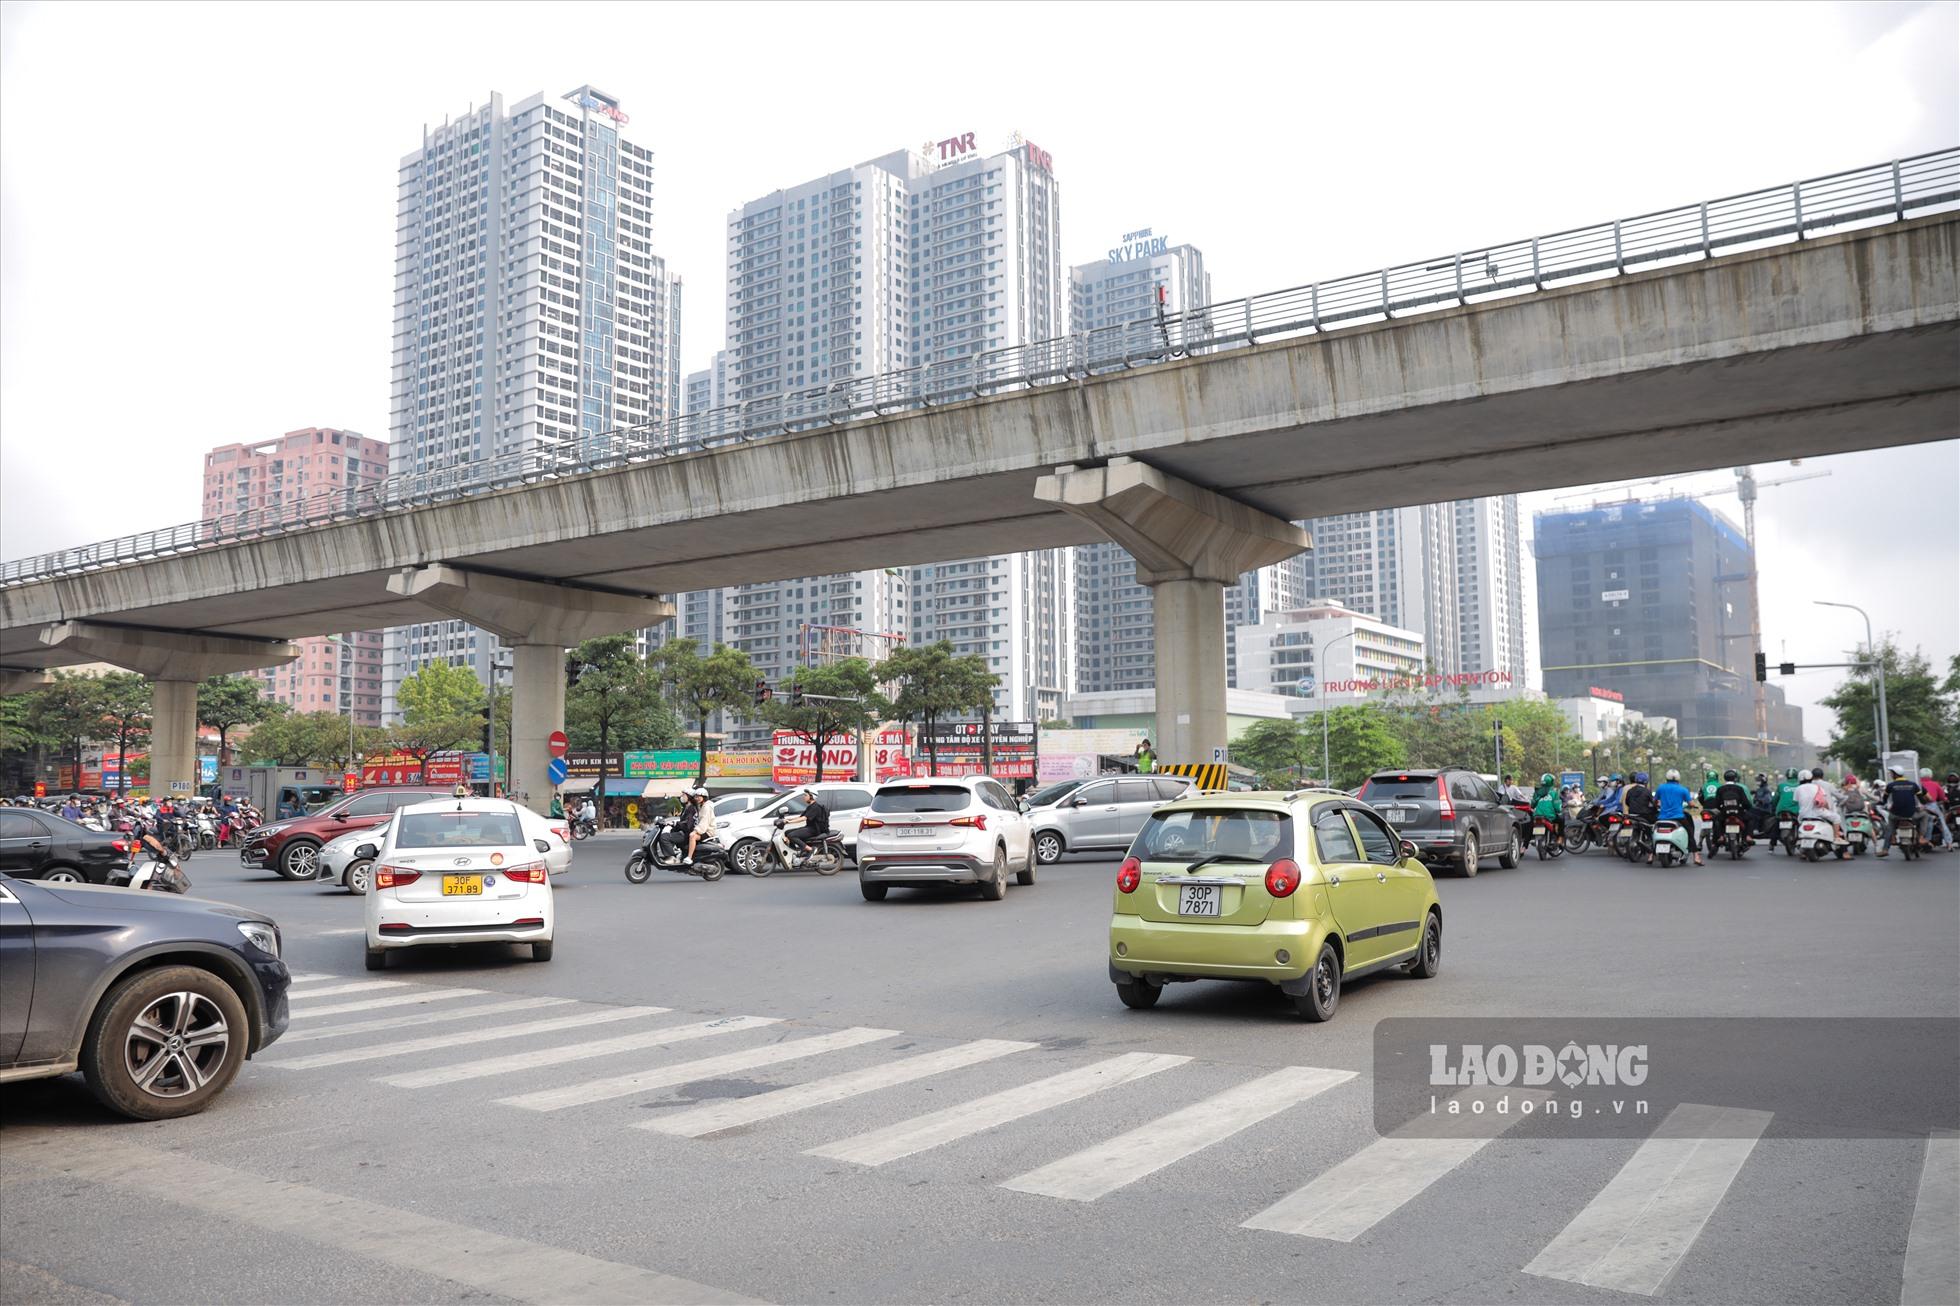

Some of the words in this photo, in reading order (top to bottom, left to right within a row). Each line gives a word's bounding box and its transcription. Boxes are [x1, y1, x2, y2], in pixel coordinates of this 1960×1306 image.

[937, 132, 977, 160] TNR
[1025, 140, 1053, 174] TNR
[1122, 227, 1152, 243] SAPPHIRE
[1109, 244, 1132, 264] SKY
[1136, 235, 1168, 258] PARK
[777, 734, 805, 745] TRUNG
[923, 736, 945, 744] TNG
[981, 734, 1008, 743] CUYÊN
[799, 749, 858, 766] HOND
[454, 876, 472, 885] 30F
[447, 885, 478, 894] 371.89
[1188, 886, 1212, 900] 30P
[1184, 900, 1214, 914] 7871
